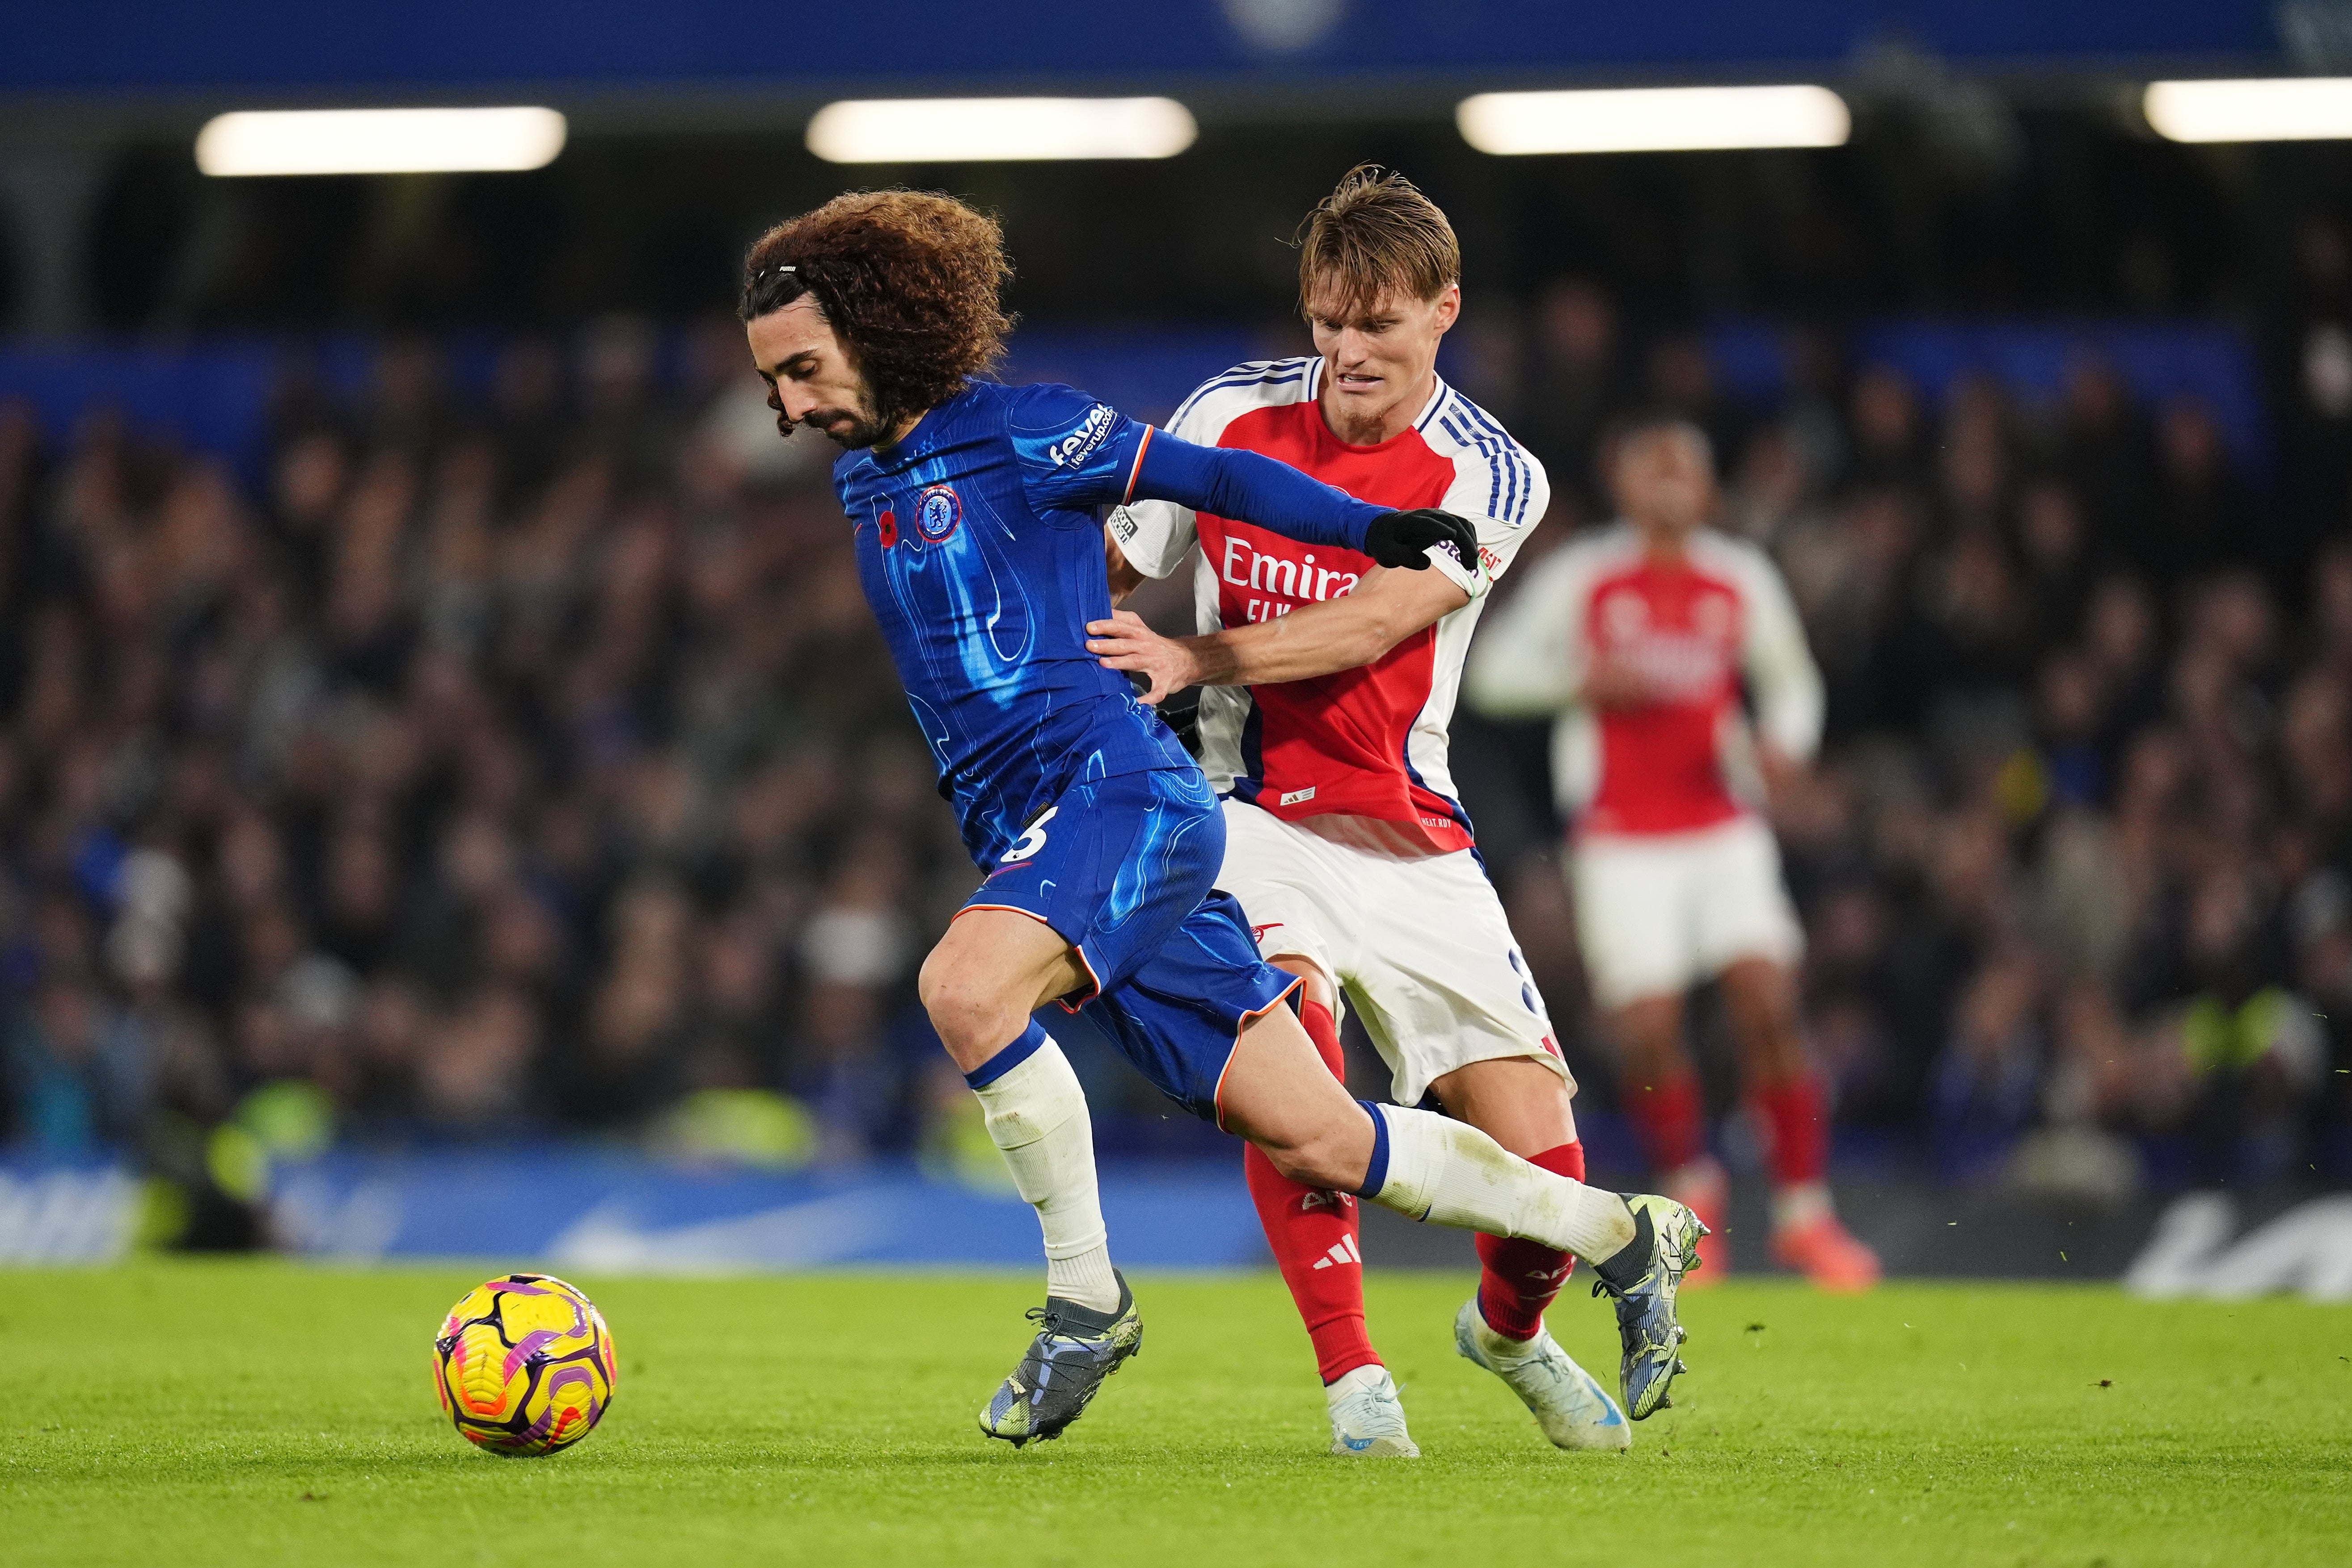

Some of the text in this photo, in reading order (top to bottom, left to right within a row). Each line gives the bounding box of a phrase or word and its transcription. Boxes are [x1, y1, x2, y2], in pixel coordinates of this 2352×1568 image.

[923, 490, 950, 502] CHELSEA
[1223, 535, 1360, 601] Emira
[1421, 817, 1451, 828] HEAT.RDY
[1302, 1190, 1352, 1210] AFC
